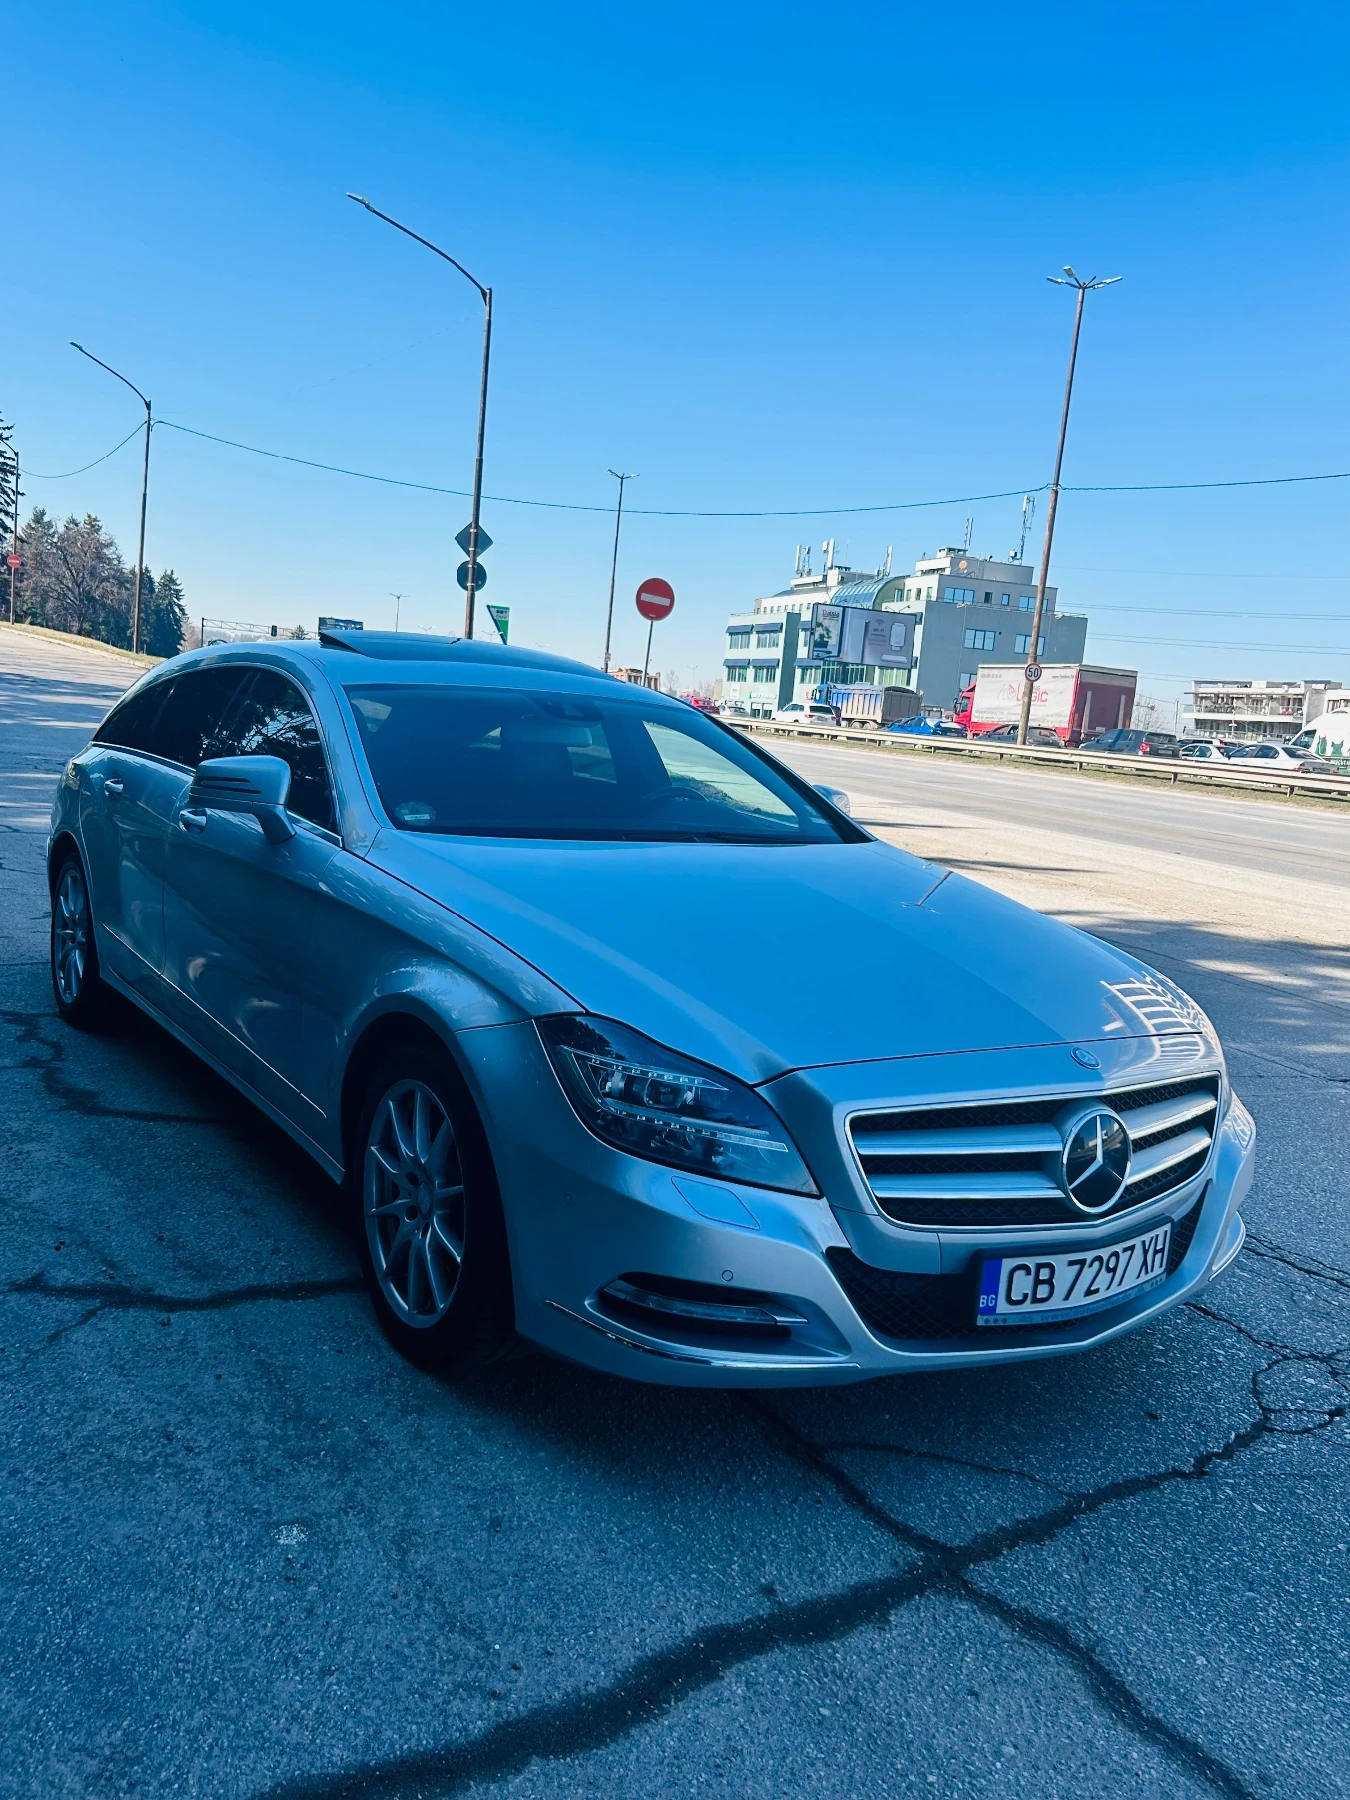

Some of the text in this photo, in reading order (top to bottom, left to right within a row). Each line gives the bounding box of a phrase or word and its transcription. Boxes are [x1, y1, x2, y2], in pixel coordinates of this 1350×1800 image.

[1028, 667, 1039, 678] 50
[1016, 684, 1049, 703] LGIC
[1005, 1261, 1056, 1306] CB
[1063, 1243, 1136, 1301] 7297
[1136, 1229, 1168, 1279] XH
[979, 1294, 996, 1308] BG
